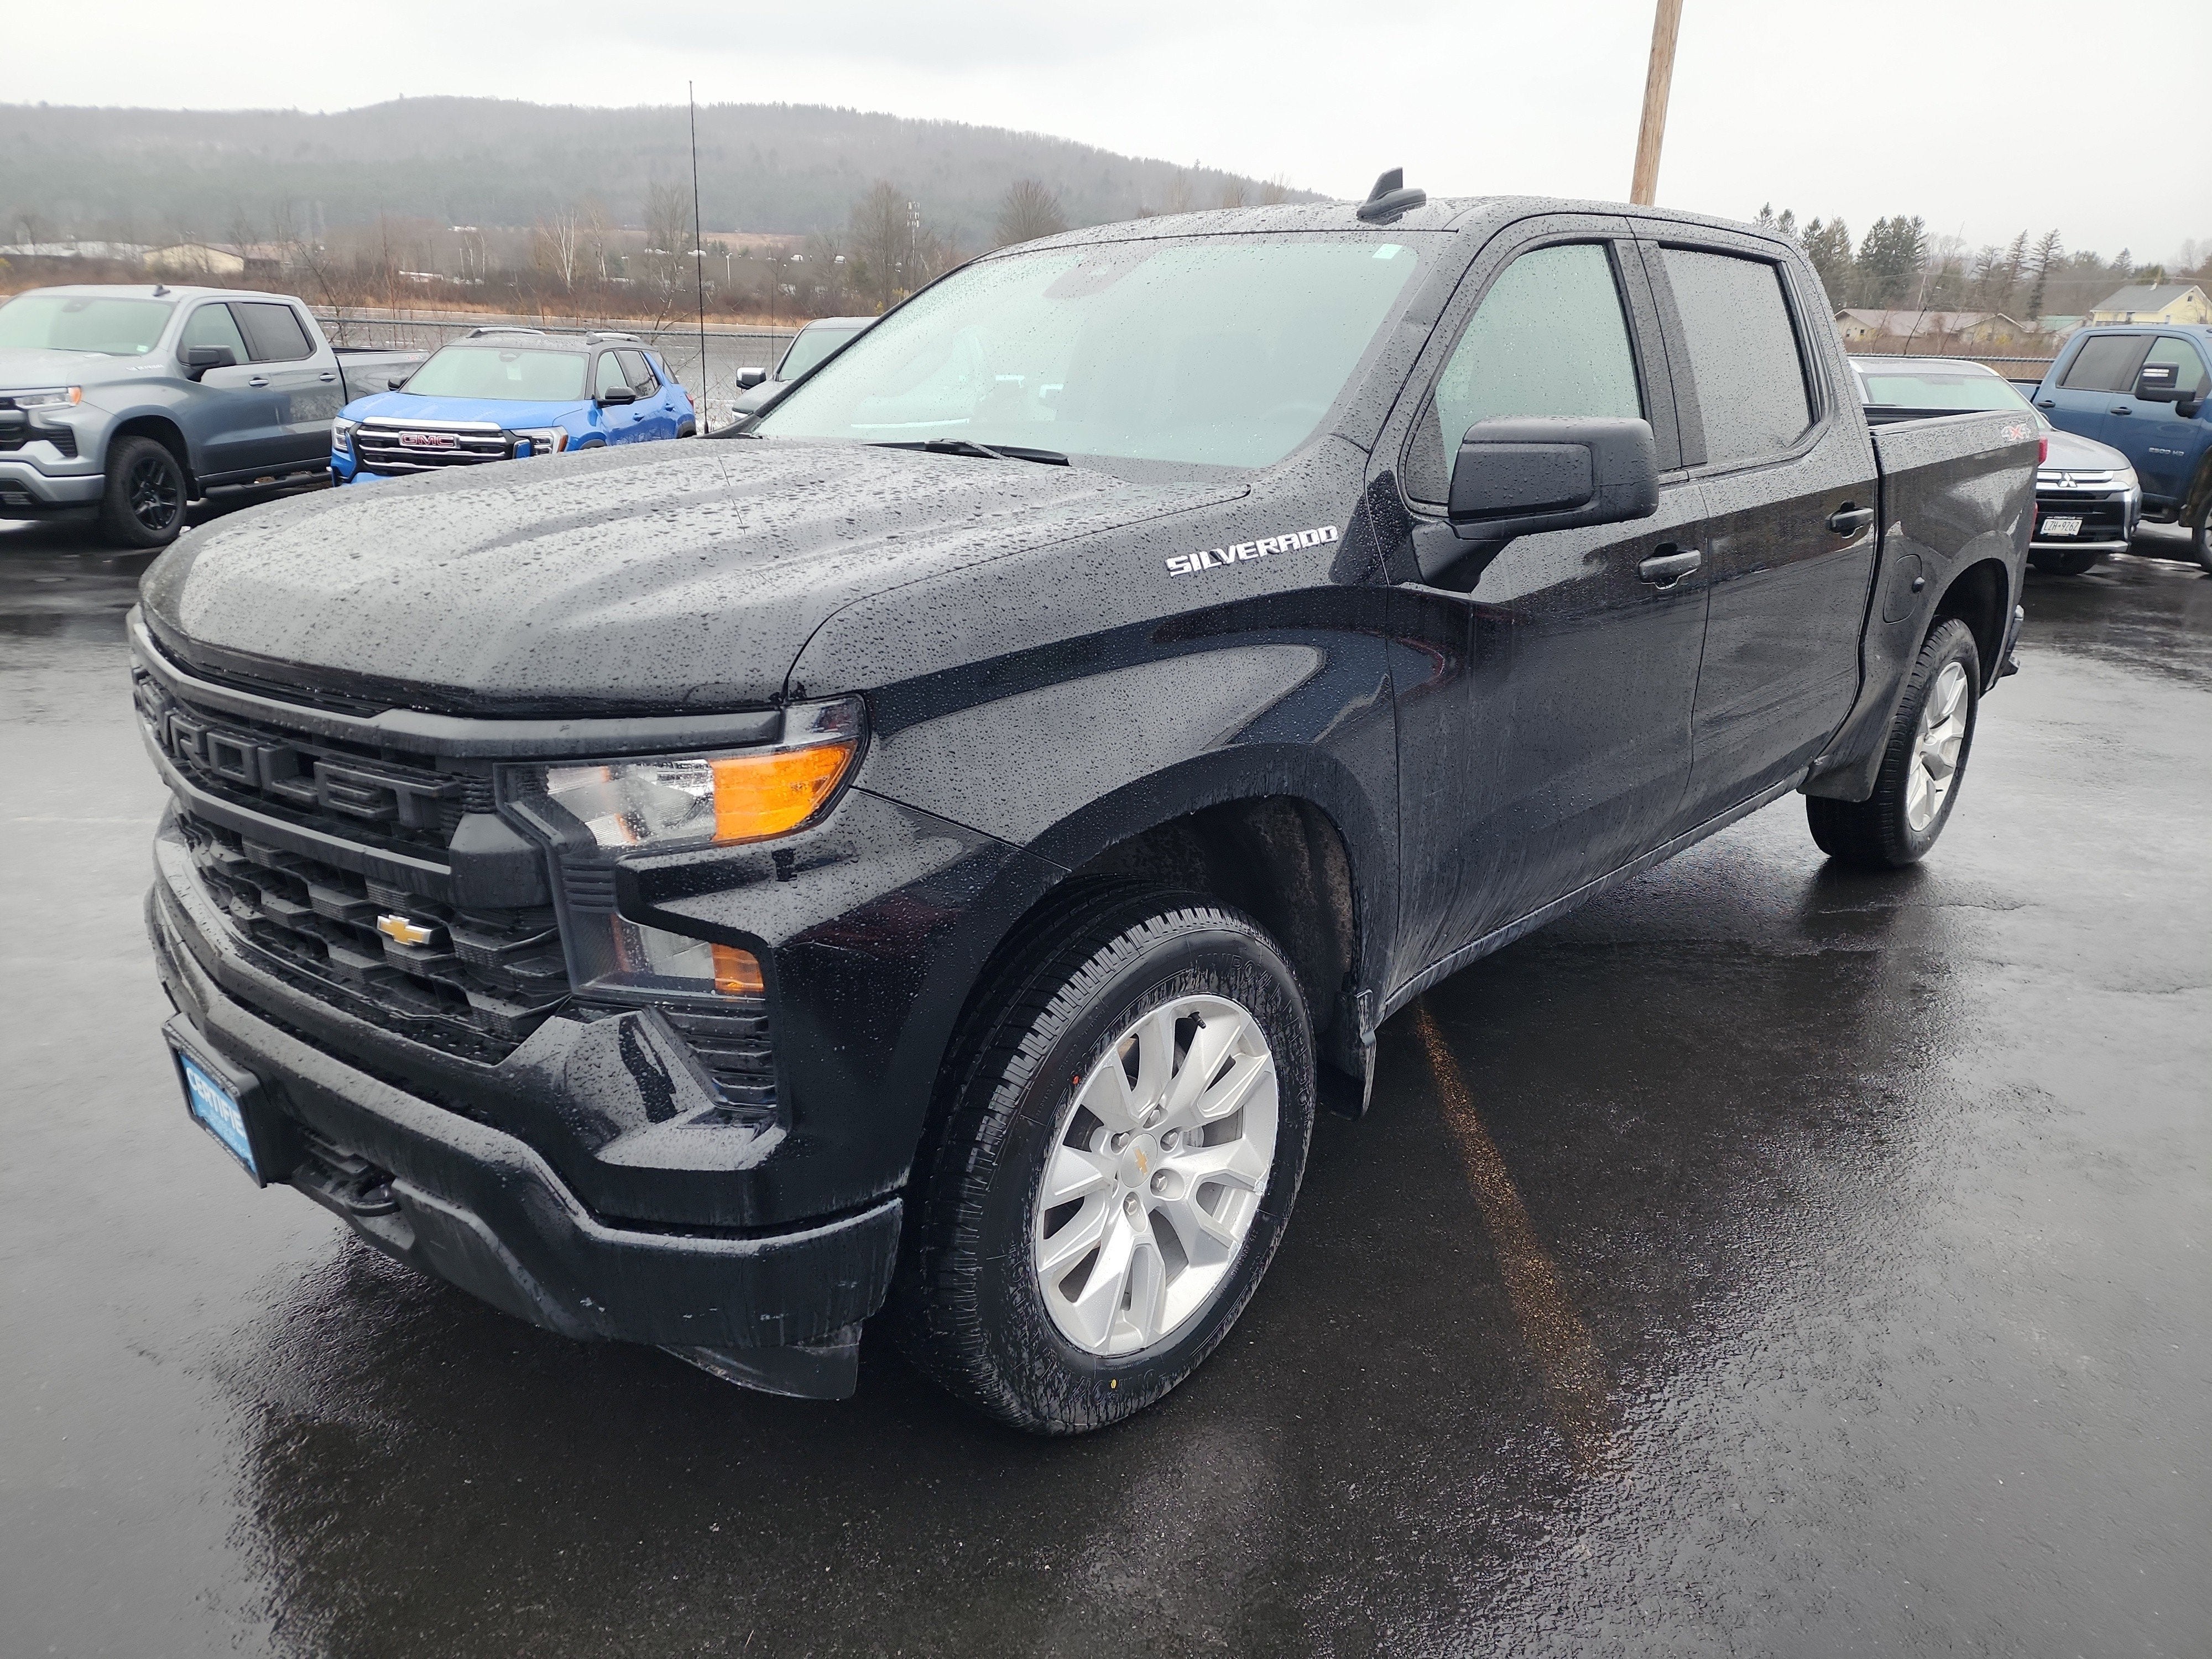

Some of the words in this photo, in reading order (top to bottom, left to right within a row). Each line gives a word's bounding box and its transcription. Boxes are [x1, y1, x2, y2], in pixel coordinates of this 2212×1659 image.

[401, 434, 455, 447] GMC
[1165, 525, 1339, 578] SILVERADO
[138, 676, 455, 828] ROLET
[186, 1067, 248, 1140] CERTIFIE
